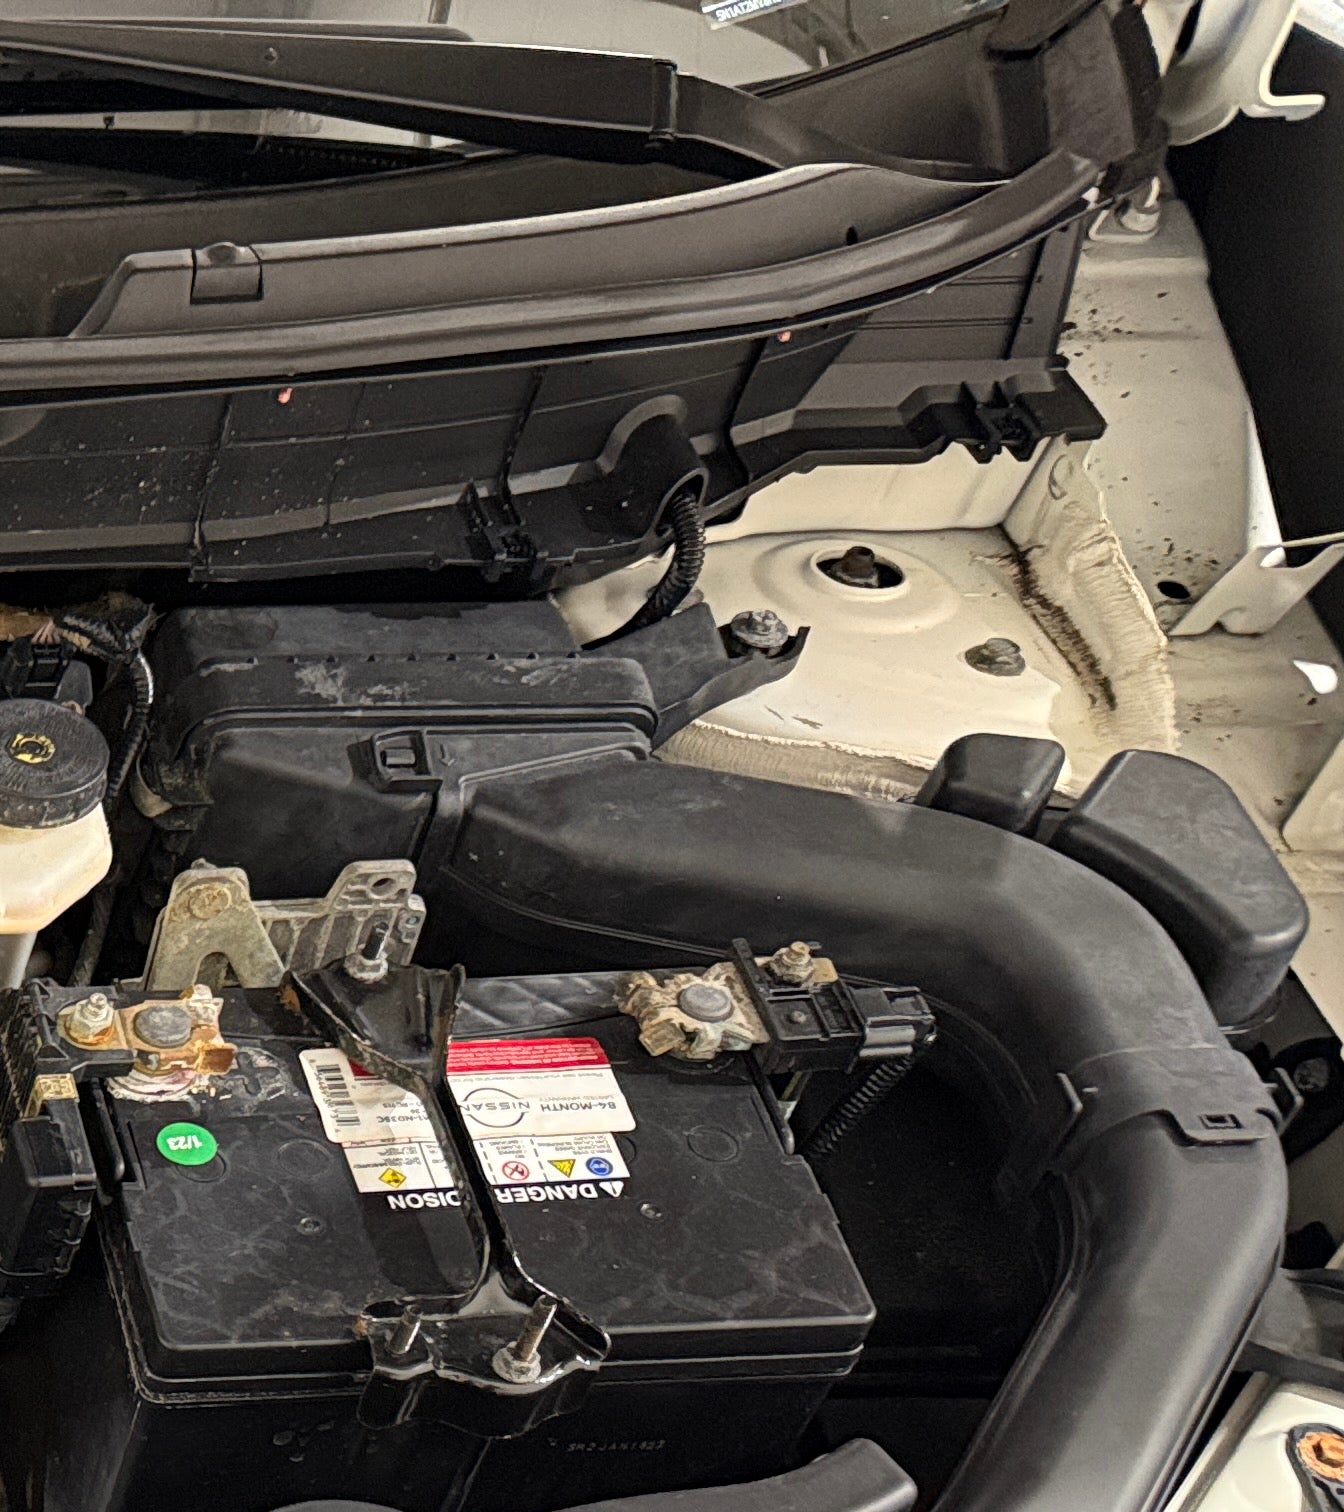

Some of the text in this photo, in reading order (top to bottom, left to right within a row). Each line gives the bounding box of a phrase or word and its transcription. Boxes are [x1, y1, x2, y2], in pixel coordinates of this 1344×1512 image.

[458, 1102, 530, 1112] NISSAN
[539, 1102, 617, 1111] 84-MONTH
[167, 1134, 203, 1151] 1/23
[387, 1182, 598, 1210] DANGER OISON
